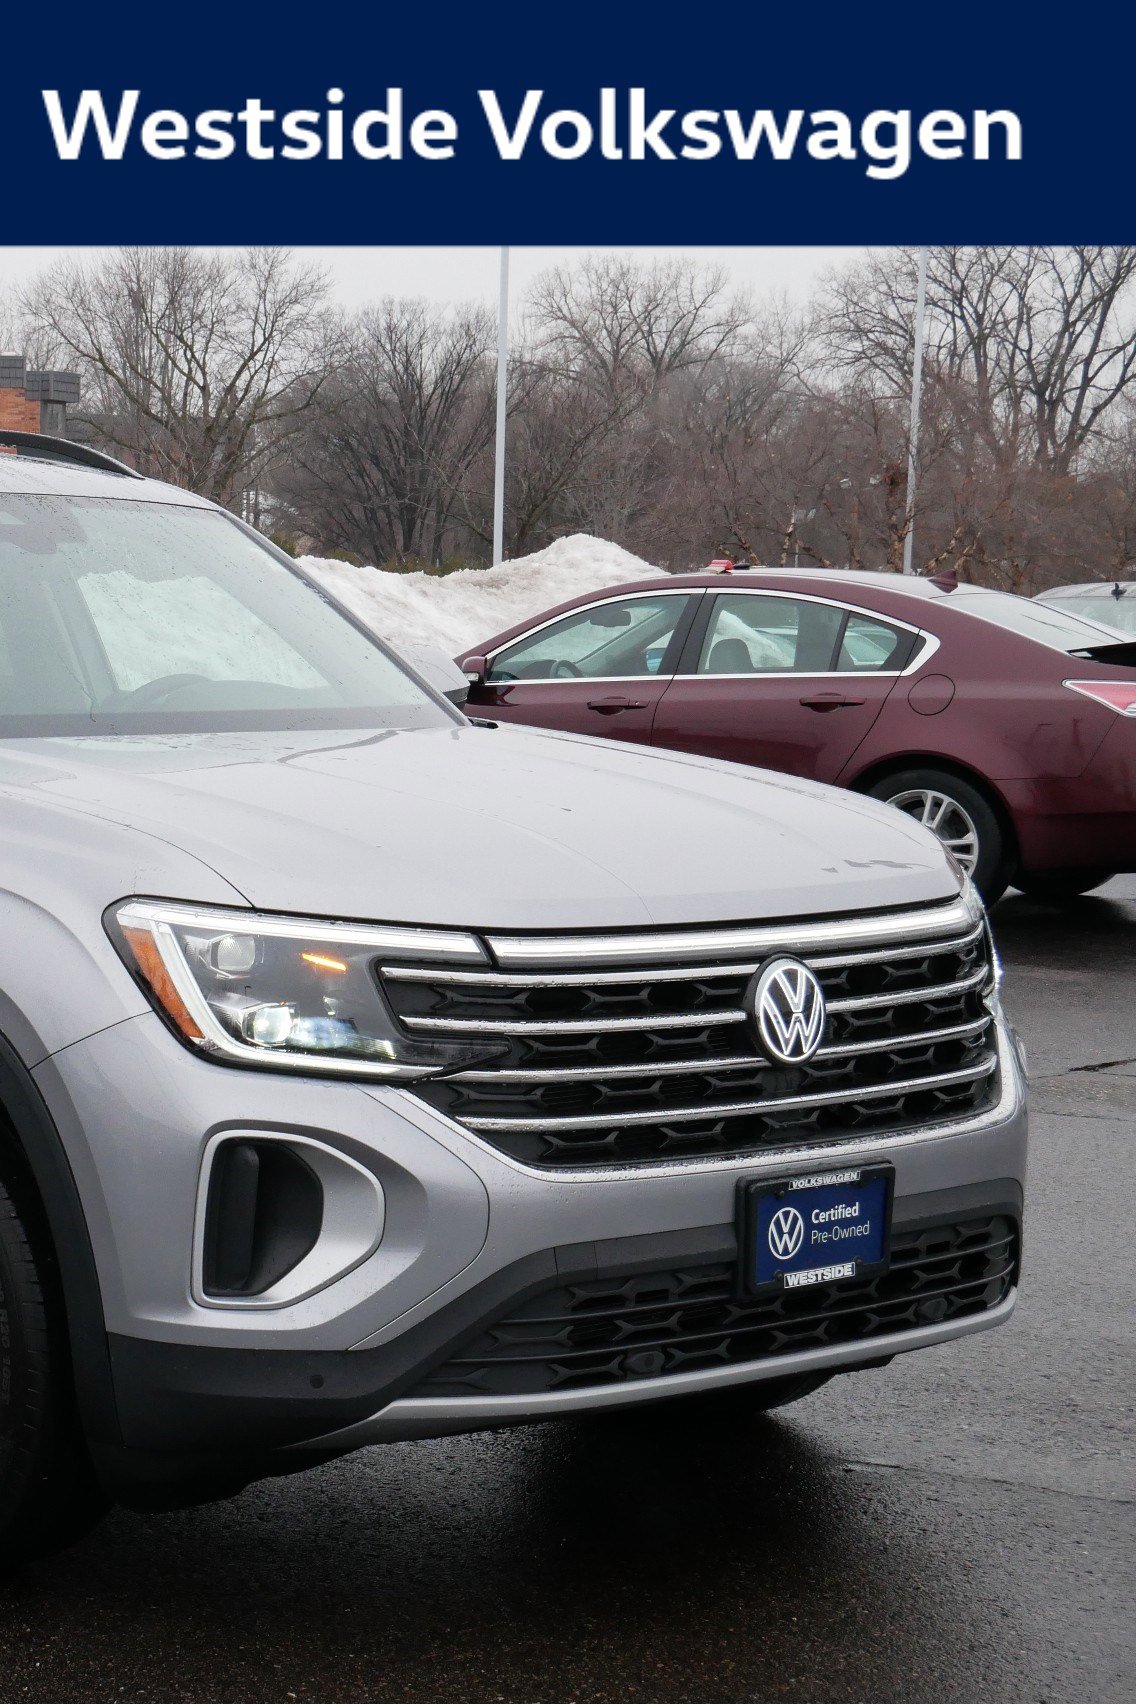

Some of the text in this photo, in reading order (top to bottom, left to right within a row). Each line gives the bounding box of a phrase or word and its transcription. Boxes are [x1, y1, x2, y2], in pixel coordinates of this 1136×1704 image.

[792, 1171, 859, 1189] VOLKSWAGEN
[811, 1202, 860, 1224] Certified
[768, 1206, 804, 1260] VW
[810, 1220, 870, 1245] Pre-Owned
[786, 1263, 853, 1287] WESTSIDE
